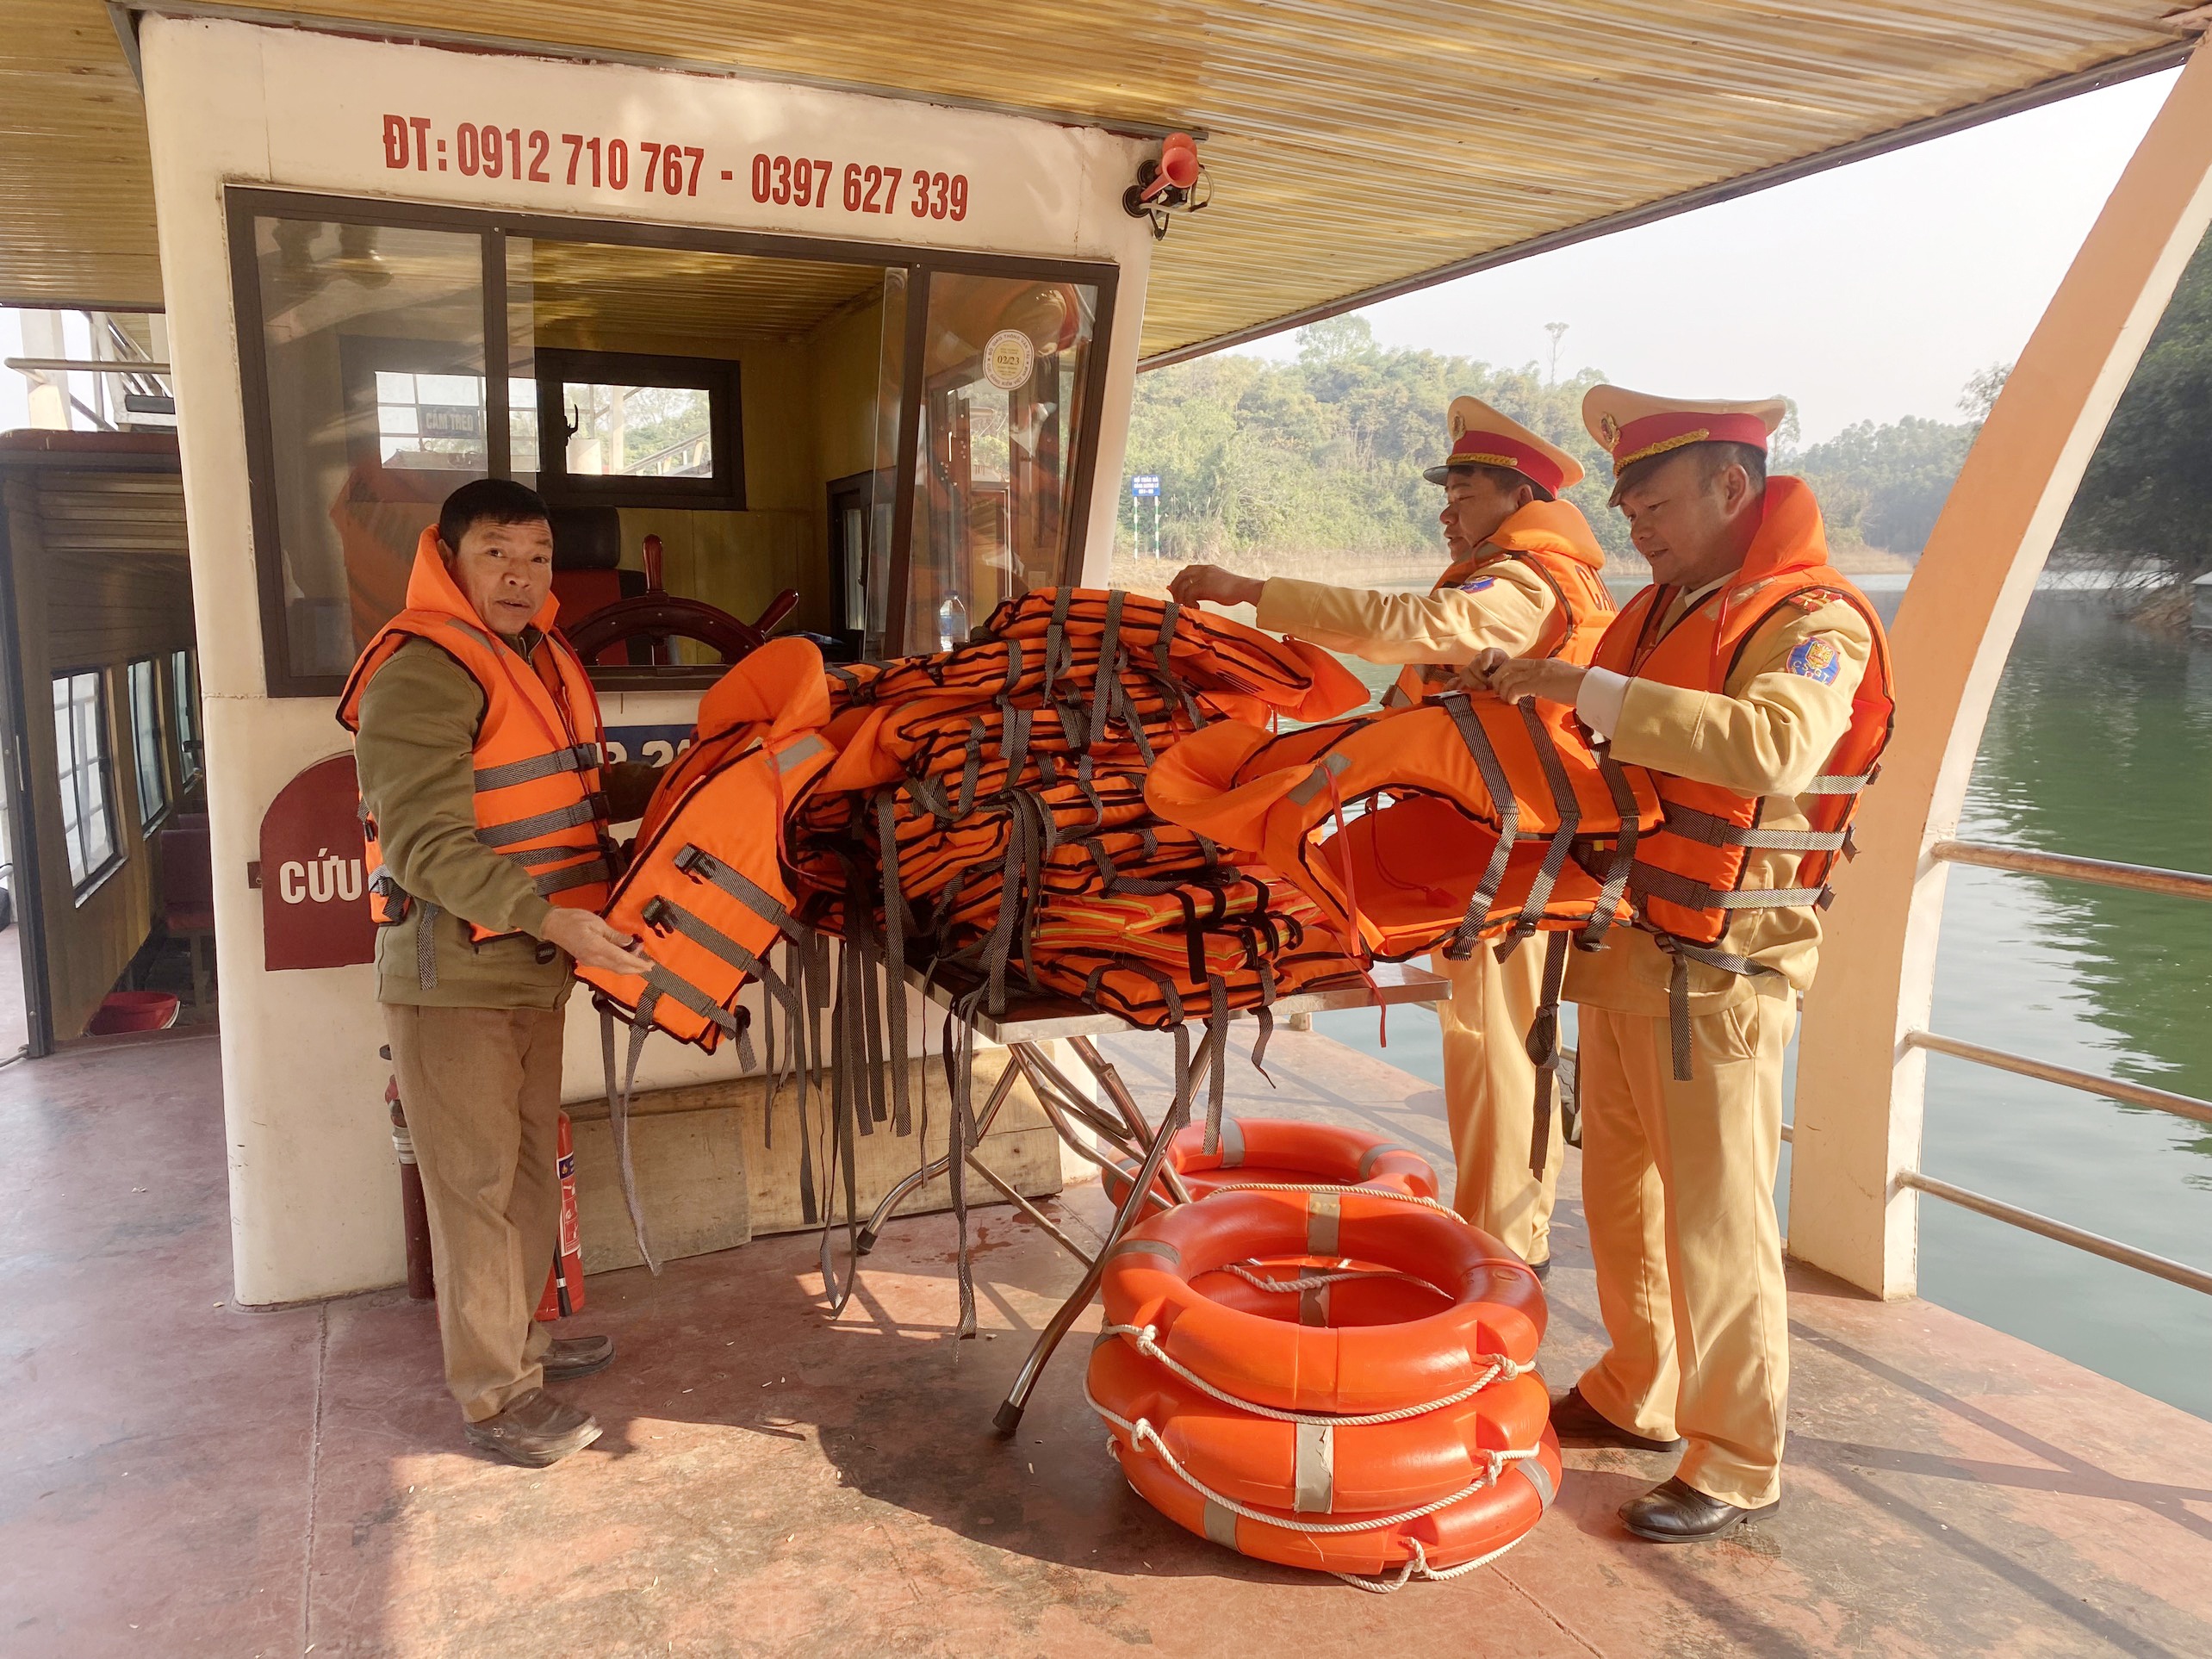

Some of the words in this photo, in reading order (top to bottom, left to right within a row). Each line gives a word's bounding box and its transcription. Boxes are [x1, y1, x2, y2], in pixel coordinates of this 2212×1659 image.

[382, 114, 448, 171] ĐT:
[457, 122, 550, 183] 0912
[561, 134, 629, 191] 710
[640, 141, 705, 197] 767
[720, 170, 733, 181] -
[751, 153, 833, 208] 0397
[843, 163, 903, 214] 627
[910, 170, 969, 222] 339
[997, 355, 1020, 365] 02/23
[1793, 660, 1830, 682] CSGT
[279, 847, 363, 904] CỨU
